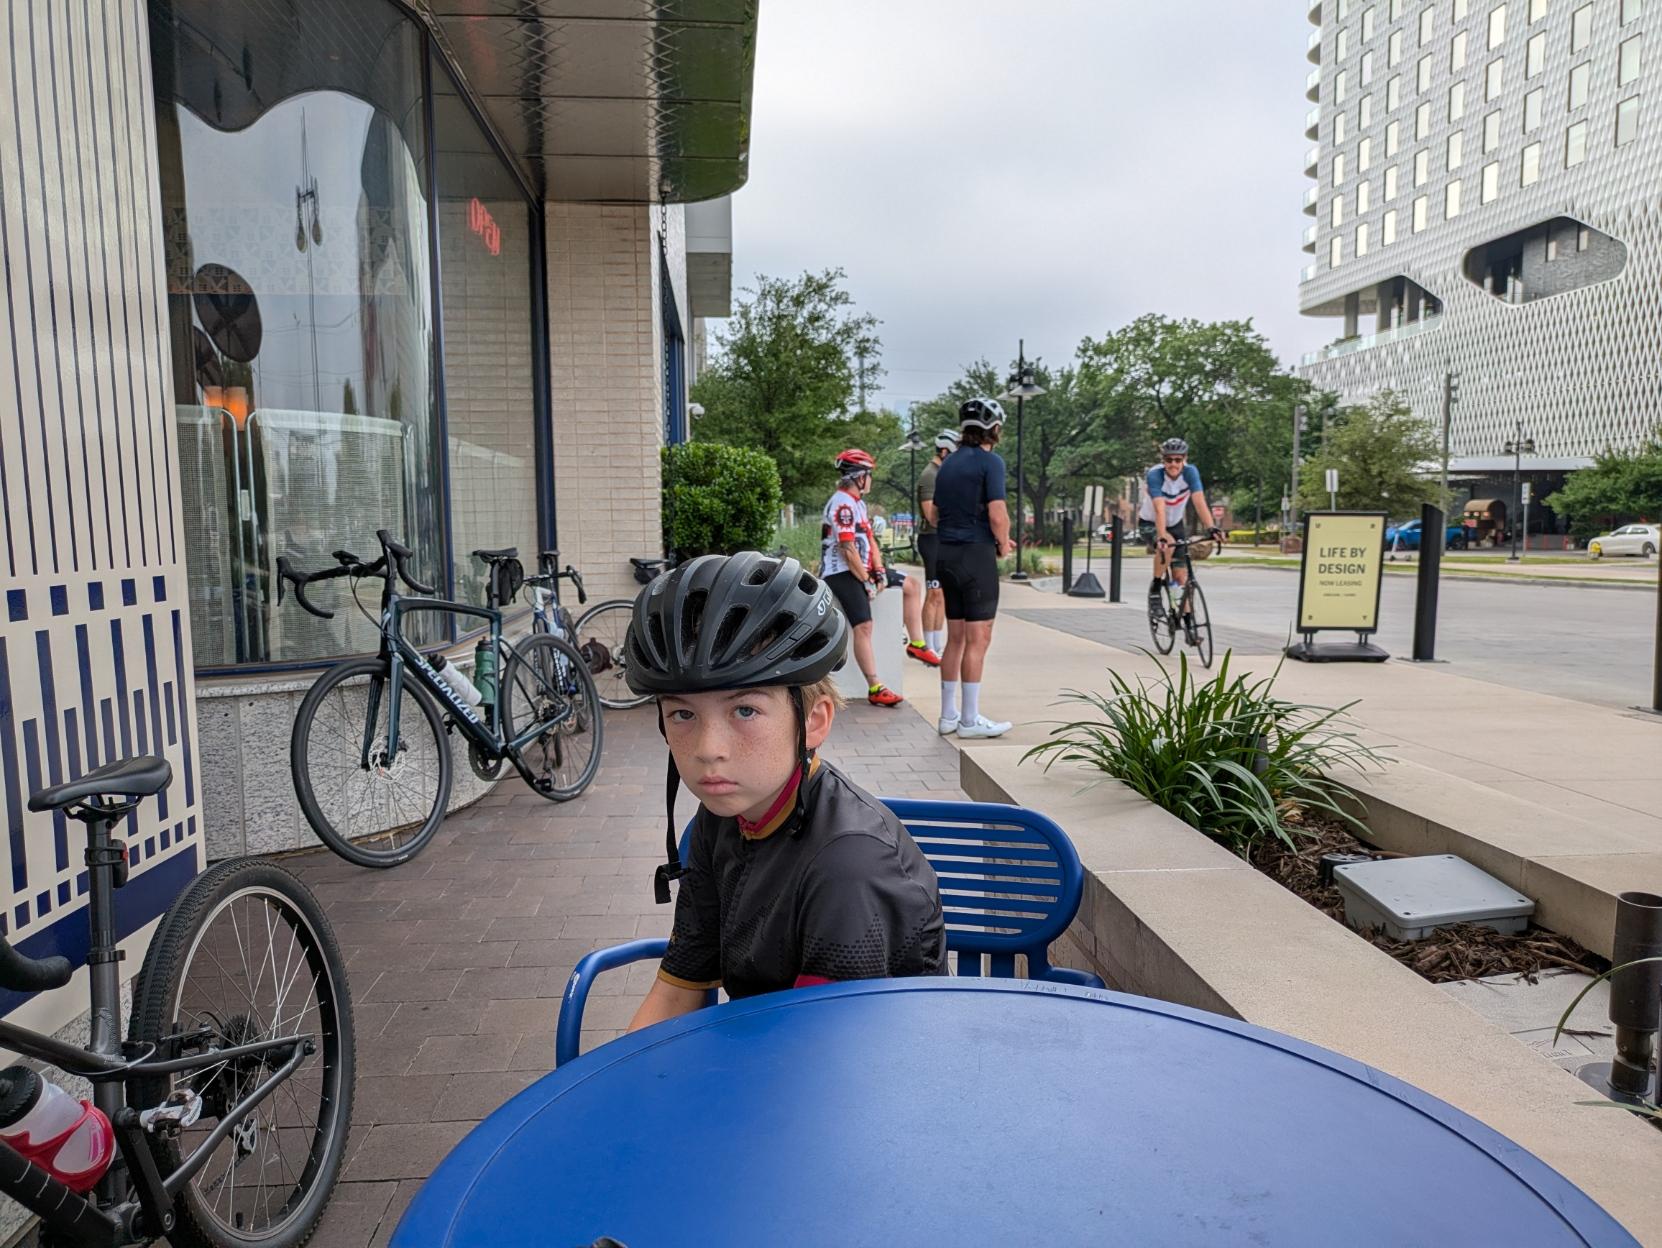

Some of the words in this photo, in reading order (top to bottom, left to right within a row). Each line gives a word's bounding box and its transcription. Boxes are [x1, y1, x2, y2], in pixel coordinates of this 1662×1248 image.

[1319, 547, 1347, 558] LIFE
[1350, 547, 1366, 558] BY
[1318, 563, 1366, 574] DESIGN
[414, 656, 479, 724] SPECIALIZED
